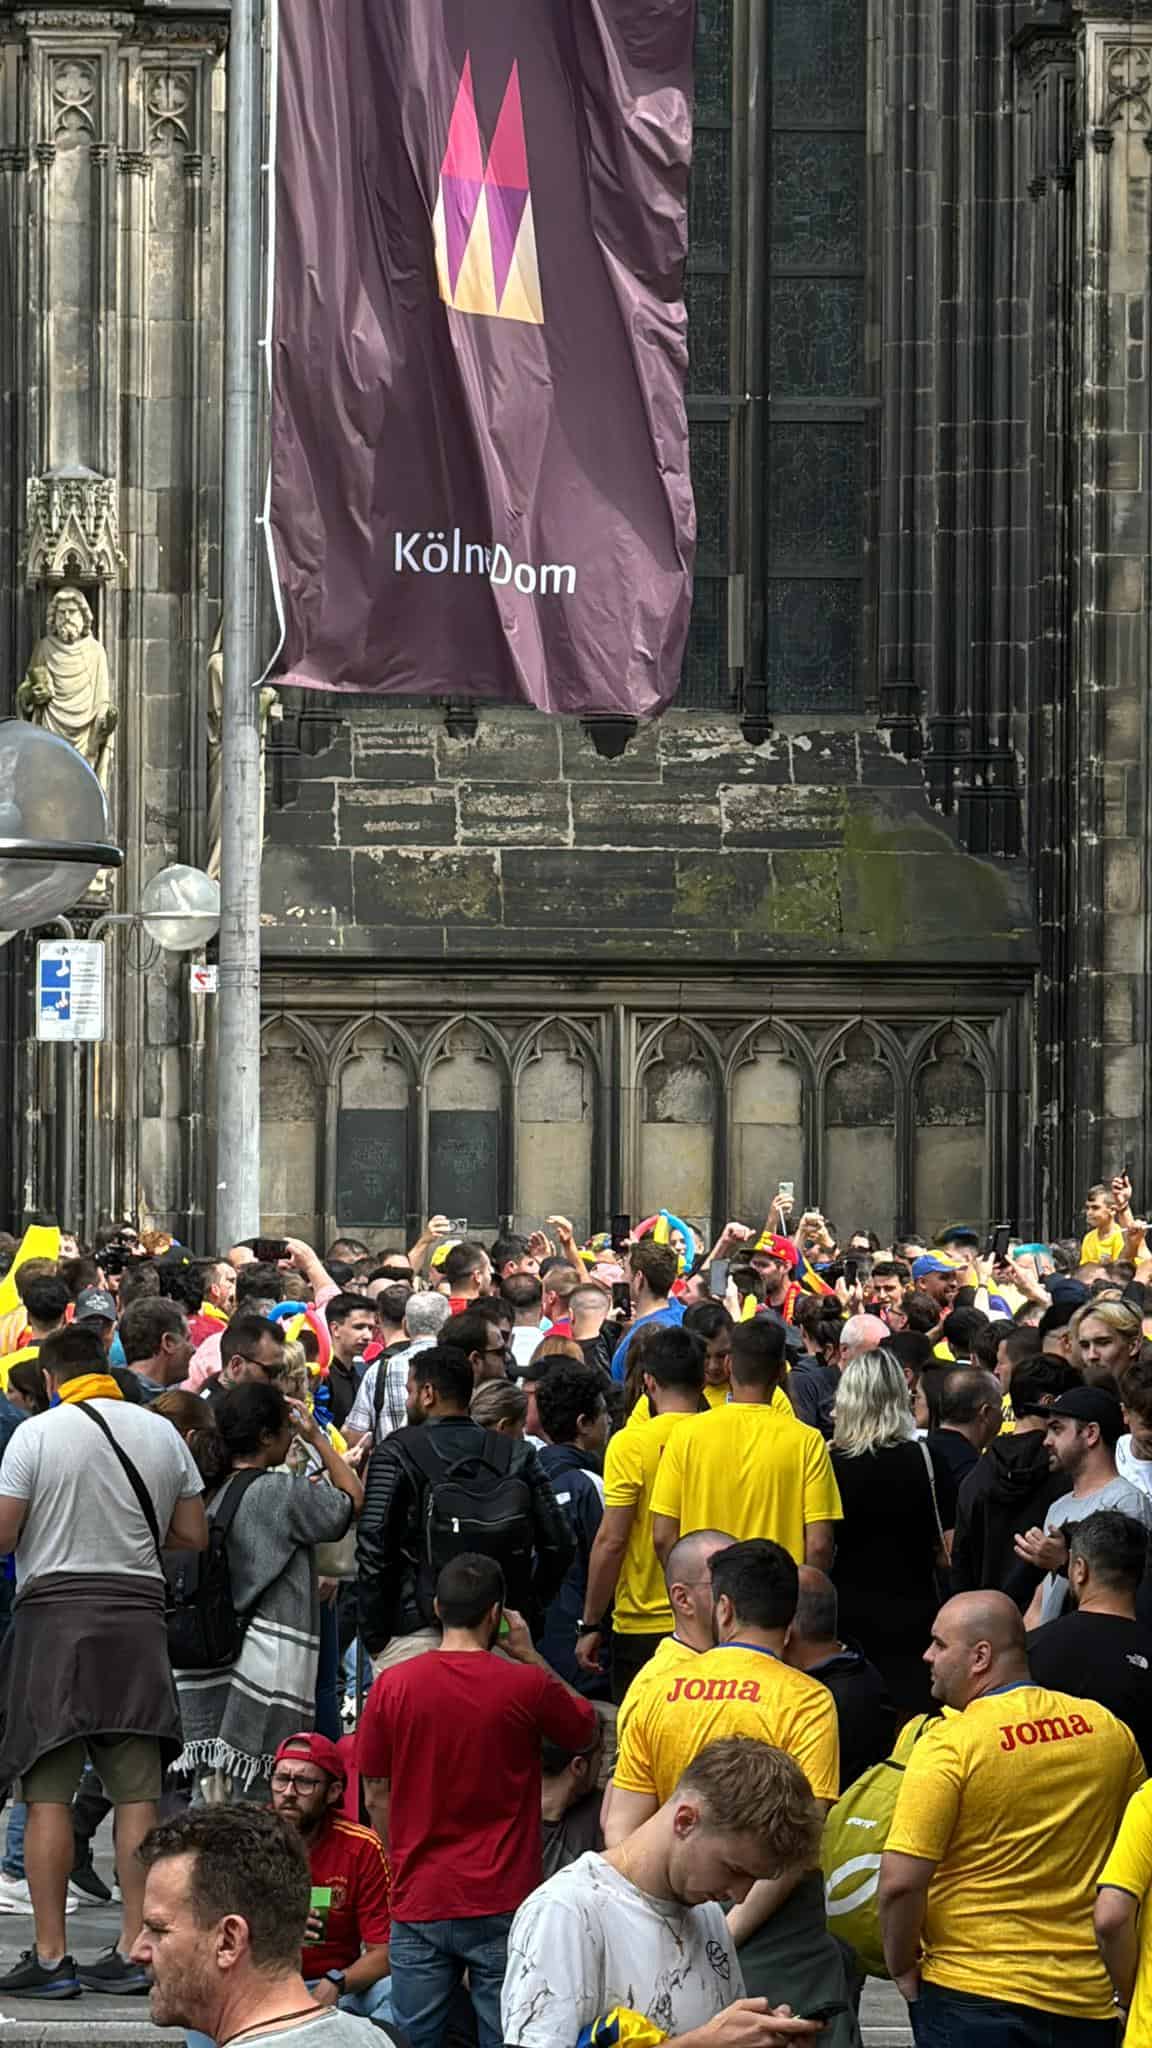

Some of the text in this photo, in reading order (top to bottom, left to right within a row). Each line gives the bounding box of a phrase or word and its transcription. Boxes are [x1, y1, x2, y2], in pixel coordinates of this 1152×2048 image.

[490, 543, 577, 594] Dom
[666, 1677, 761, 1702] Joma
[999, 1714, 1094, 1751] Joma
